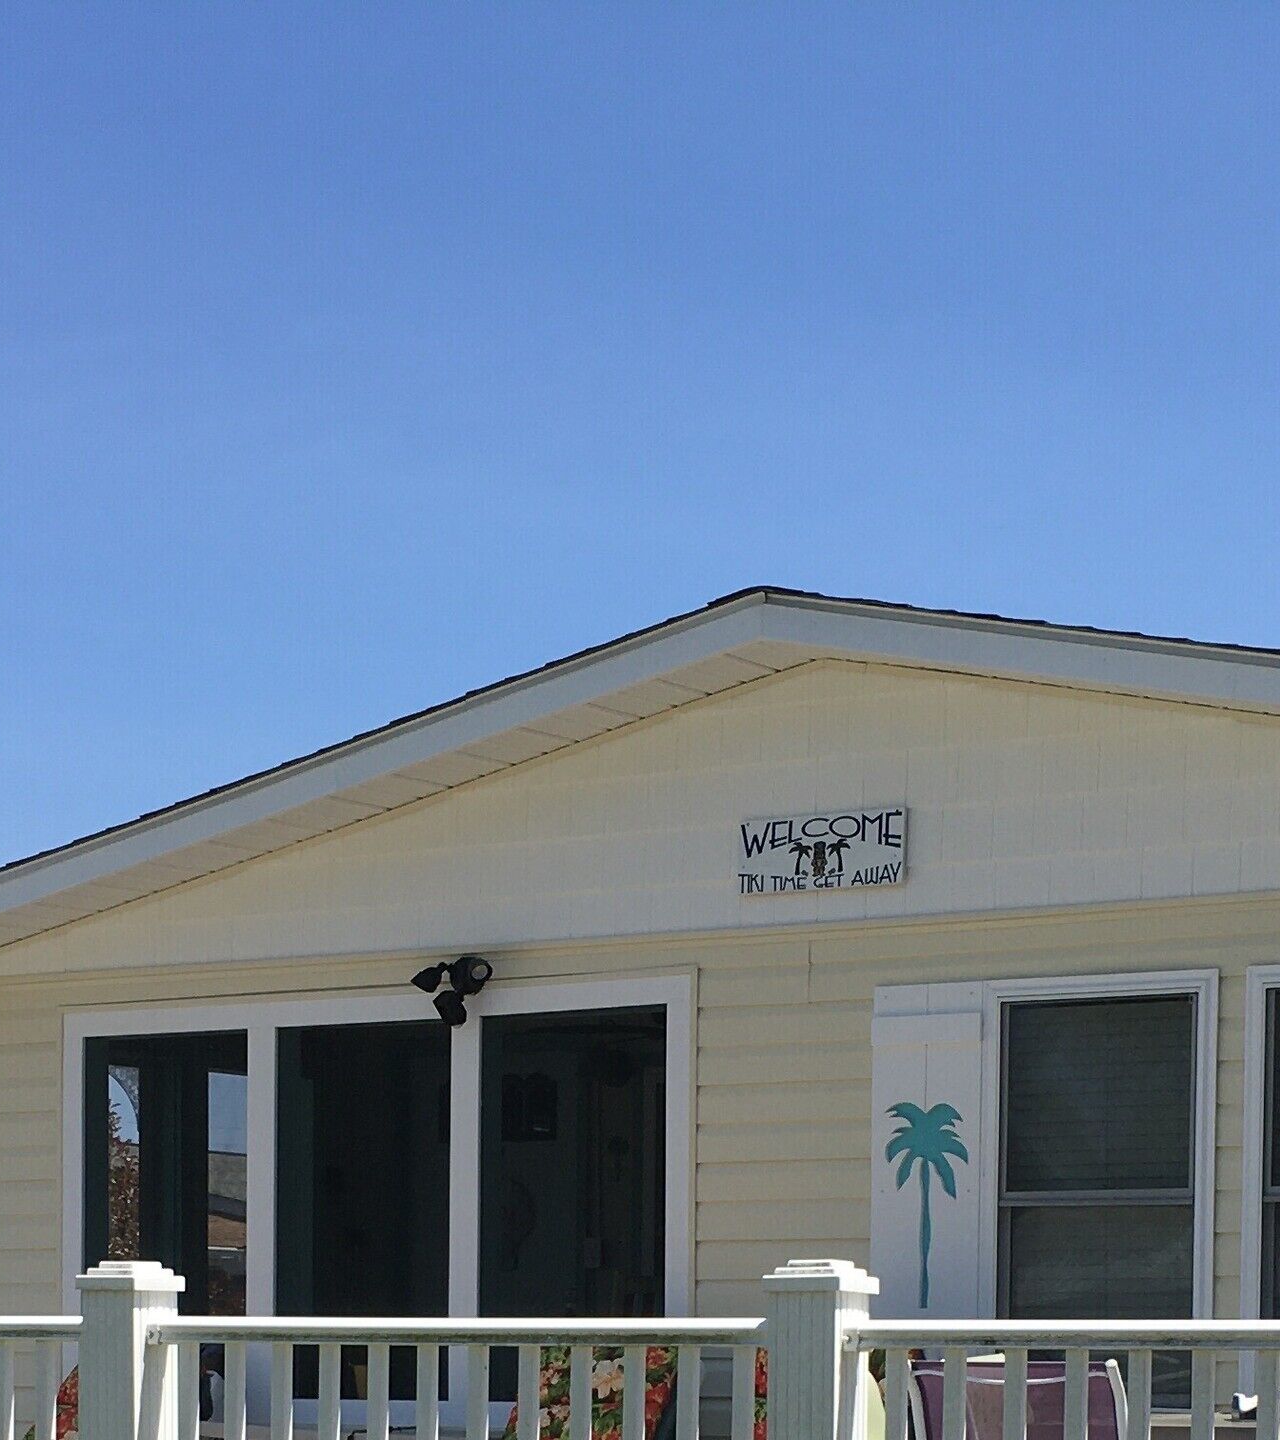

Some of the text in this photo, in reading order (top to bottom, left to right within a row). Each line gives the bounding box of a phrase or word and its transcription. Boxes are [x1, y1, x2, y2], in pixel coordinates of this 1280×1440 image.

[740, 809, 903, 859] WELCOME
[738, 861, 902, 894] TIKI TIME GET AWAY
